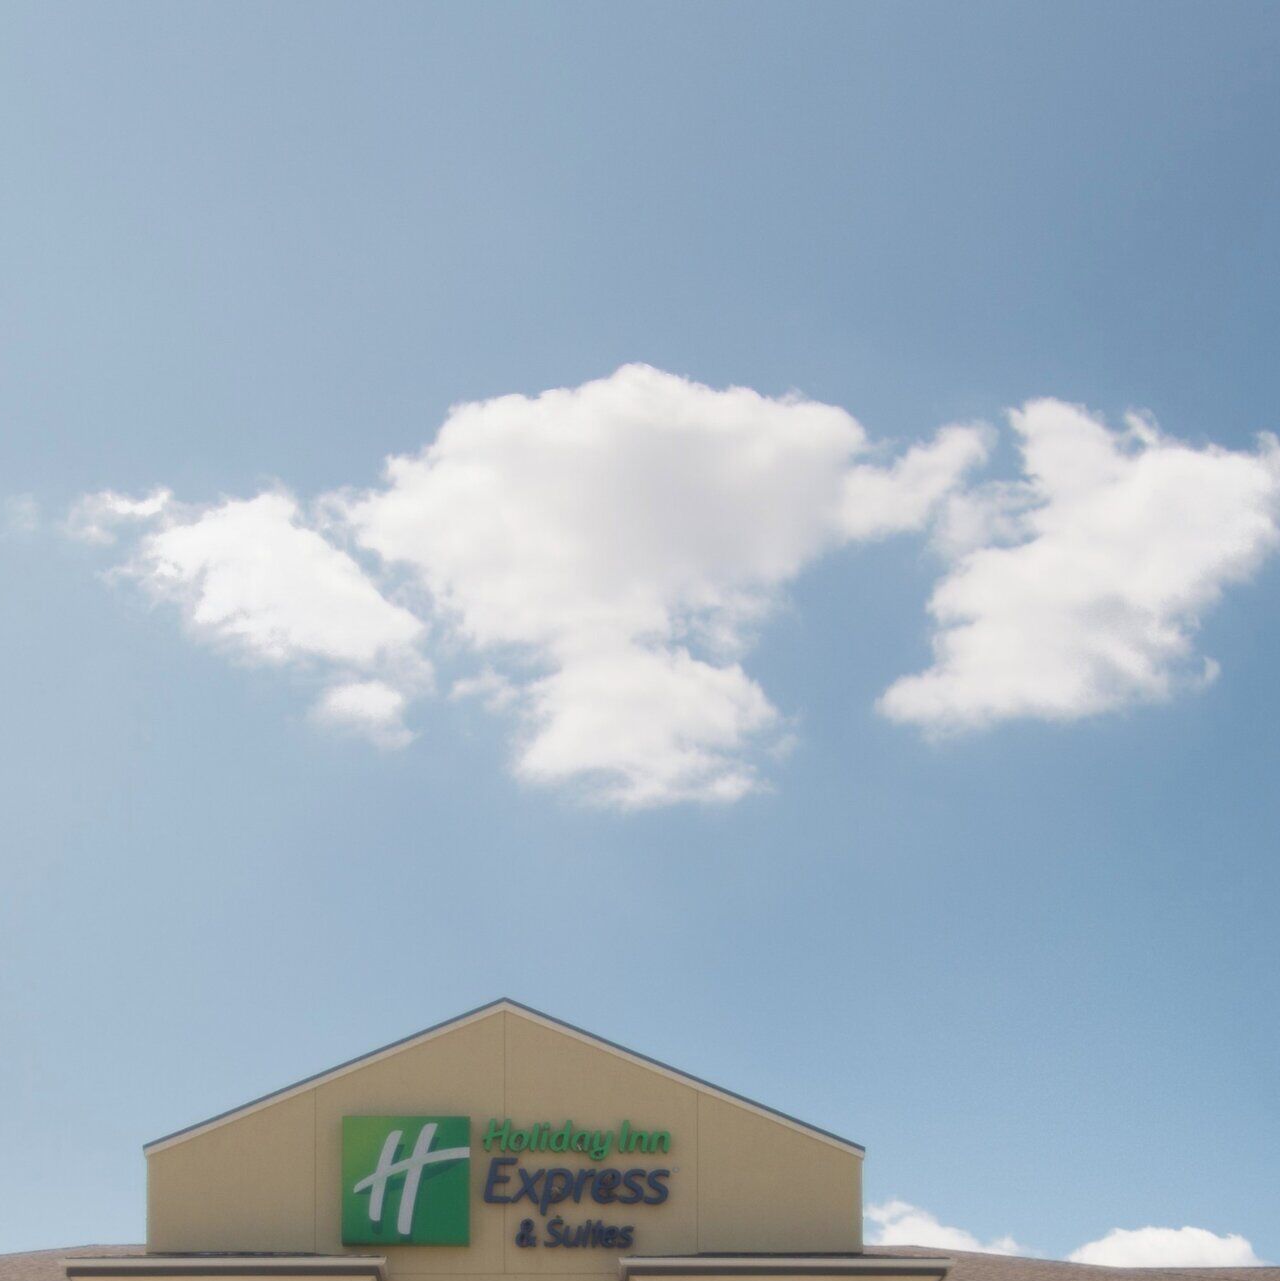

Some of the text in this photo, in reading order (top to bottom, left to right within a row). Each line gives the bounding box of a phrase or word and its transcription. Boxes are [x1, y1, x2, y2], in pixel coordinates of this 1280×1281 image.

[483, 1118, 671, 1161] Holiday Inn
[484, 1157, 669, 1216] Express
[515, 1217, 634, 1248] & Suites
